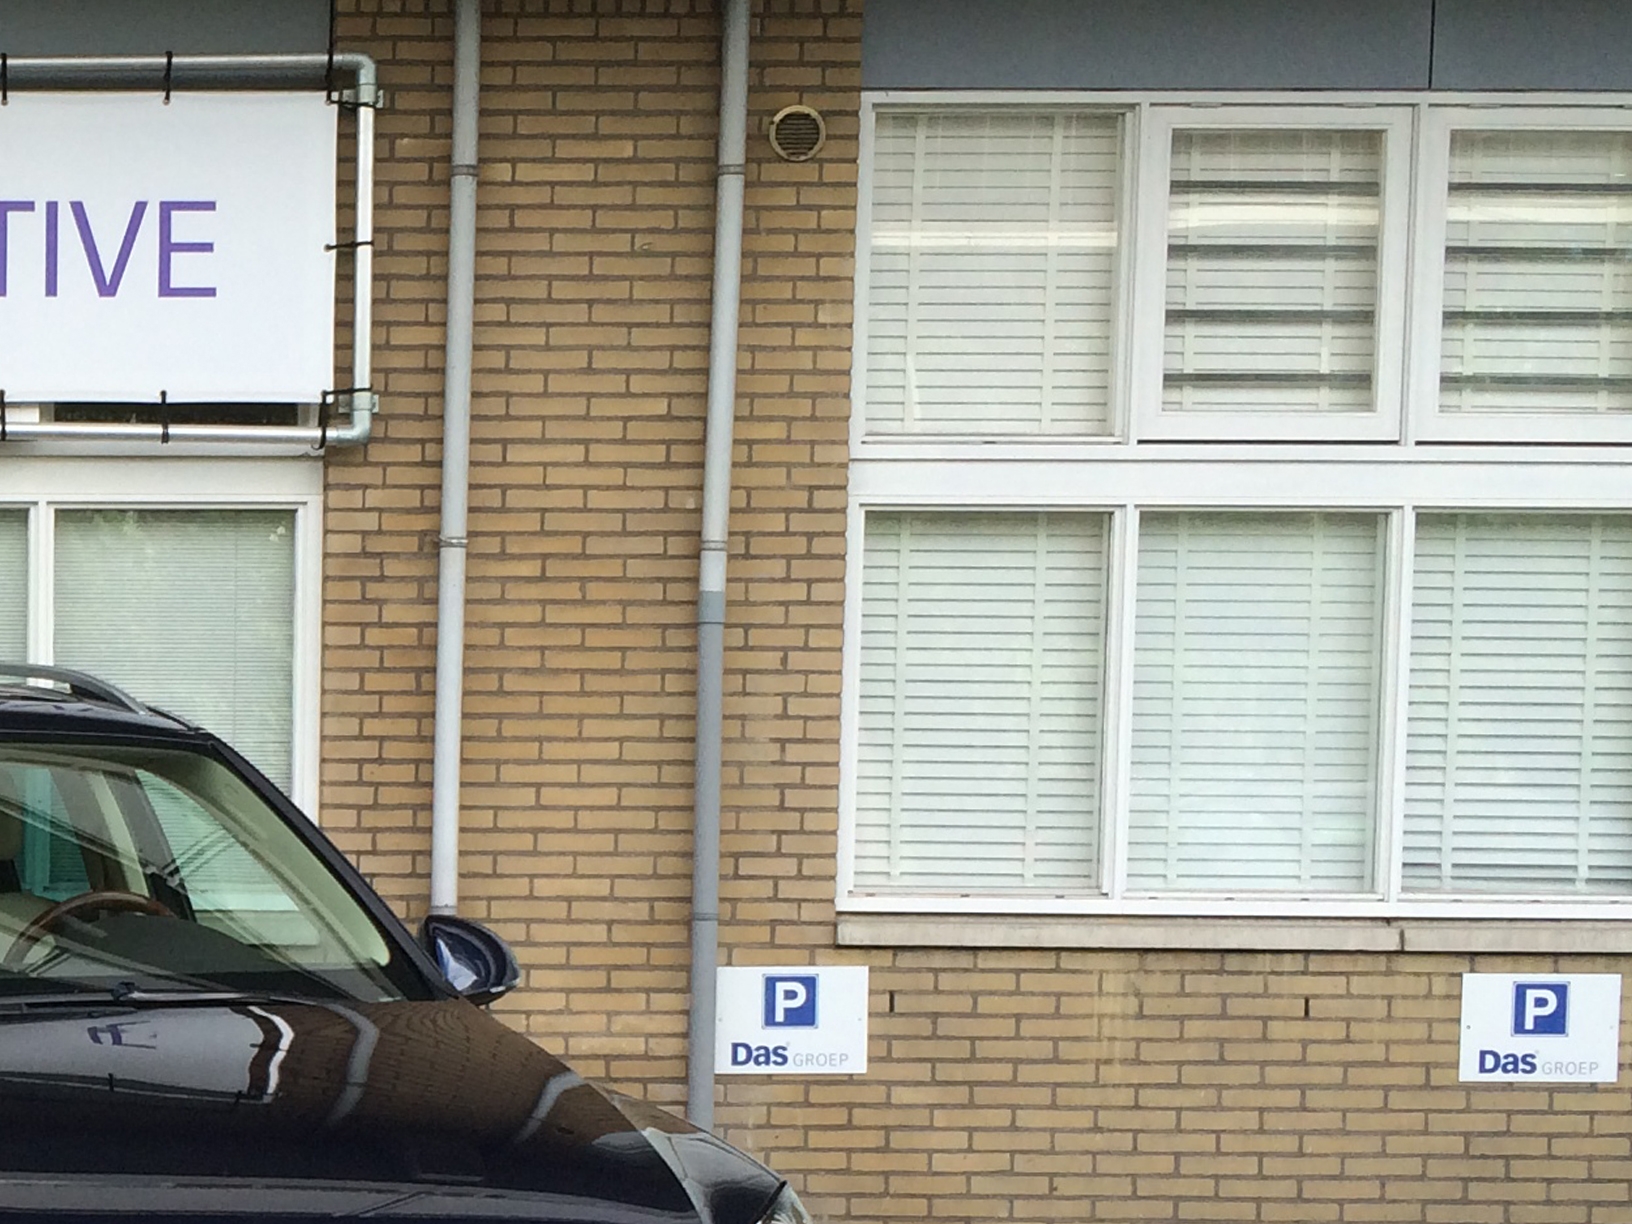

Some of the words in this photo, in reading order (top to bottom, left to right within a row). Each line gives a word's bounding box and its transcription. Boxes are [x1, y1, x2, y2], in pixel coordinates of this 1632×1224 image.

[774, 981, 807, 1022] P
[1524, 989, 1558, 1030] P
[730, 1042, 789, 1066] Das
[792, 1053, 849, 1067] GROEP
[1478, 1049, 1537, 1074] Das
[1541, 1061, 1599, 1076] GROEP
